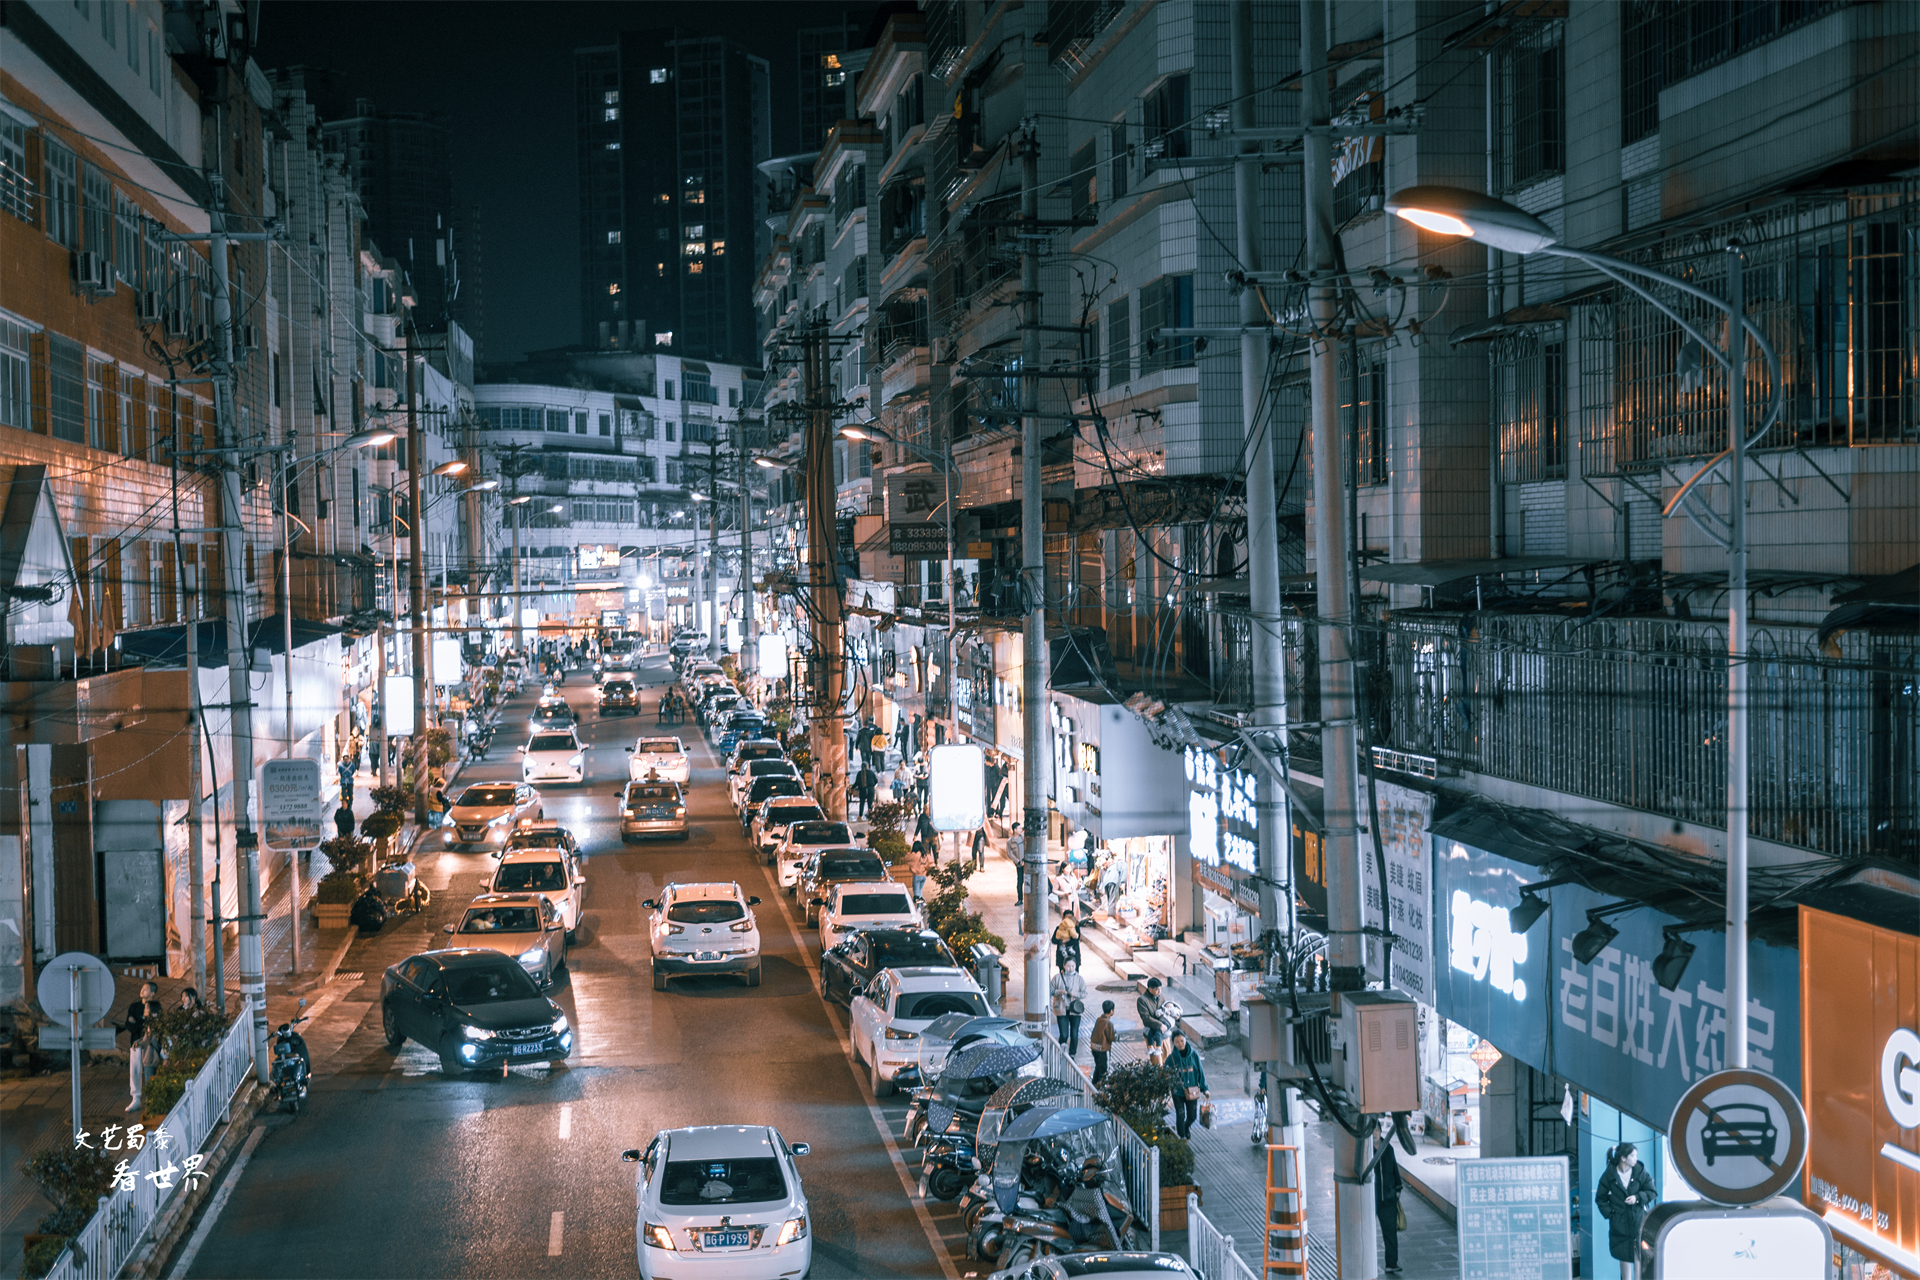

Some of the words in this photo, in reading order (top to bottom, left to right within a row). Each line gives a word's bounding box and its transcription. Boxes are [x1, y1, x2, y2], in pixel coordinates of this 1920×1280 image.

[905, 479, 937, 514] 武
[1561, 933, 1775, 1083] 老百姓大药房
[1470, 1186, 1558, 1202] 民主路占道临时停车点
